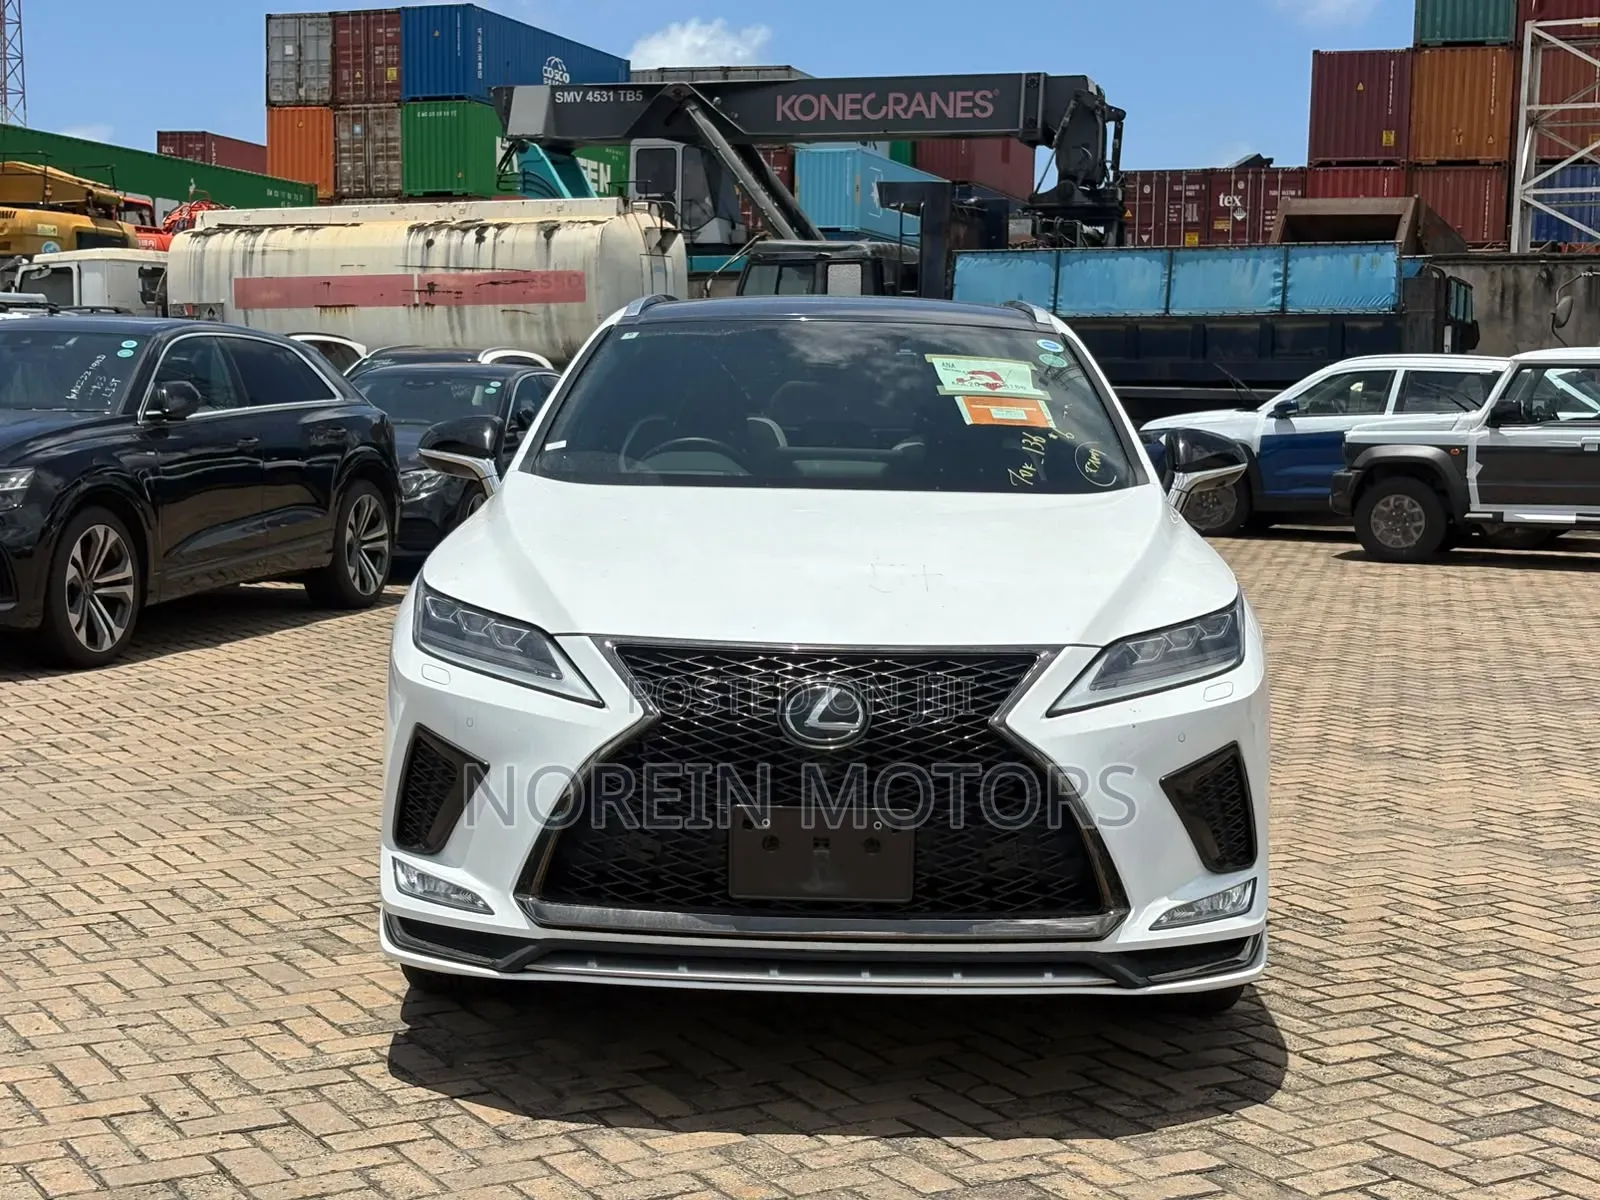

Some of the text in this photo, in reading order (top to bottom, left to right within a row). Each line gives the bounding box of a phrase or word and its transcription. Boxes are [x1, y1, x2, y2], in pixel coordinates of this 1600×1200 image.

[555, 89, 643, 103] SMV 4531 TB5
[776, 89, 994, 121] KONECRANES
[1218, 192, 1242, 207] tex
